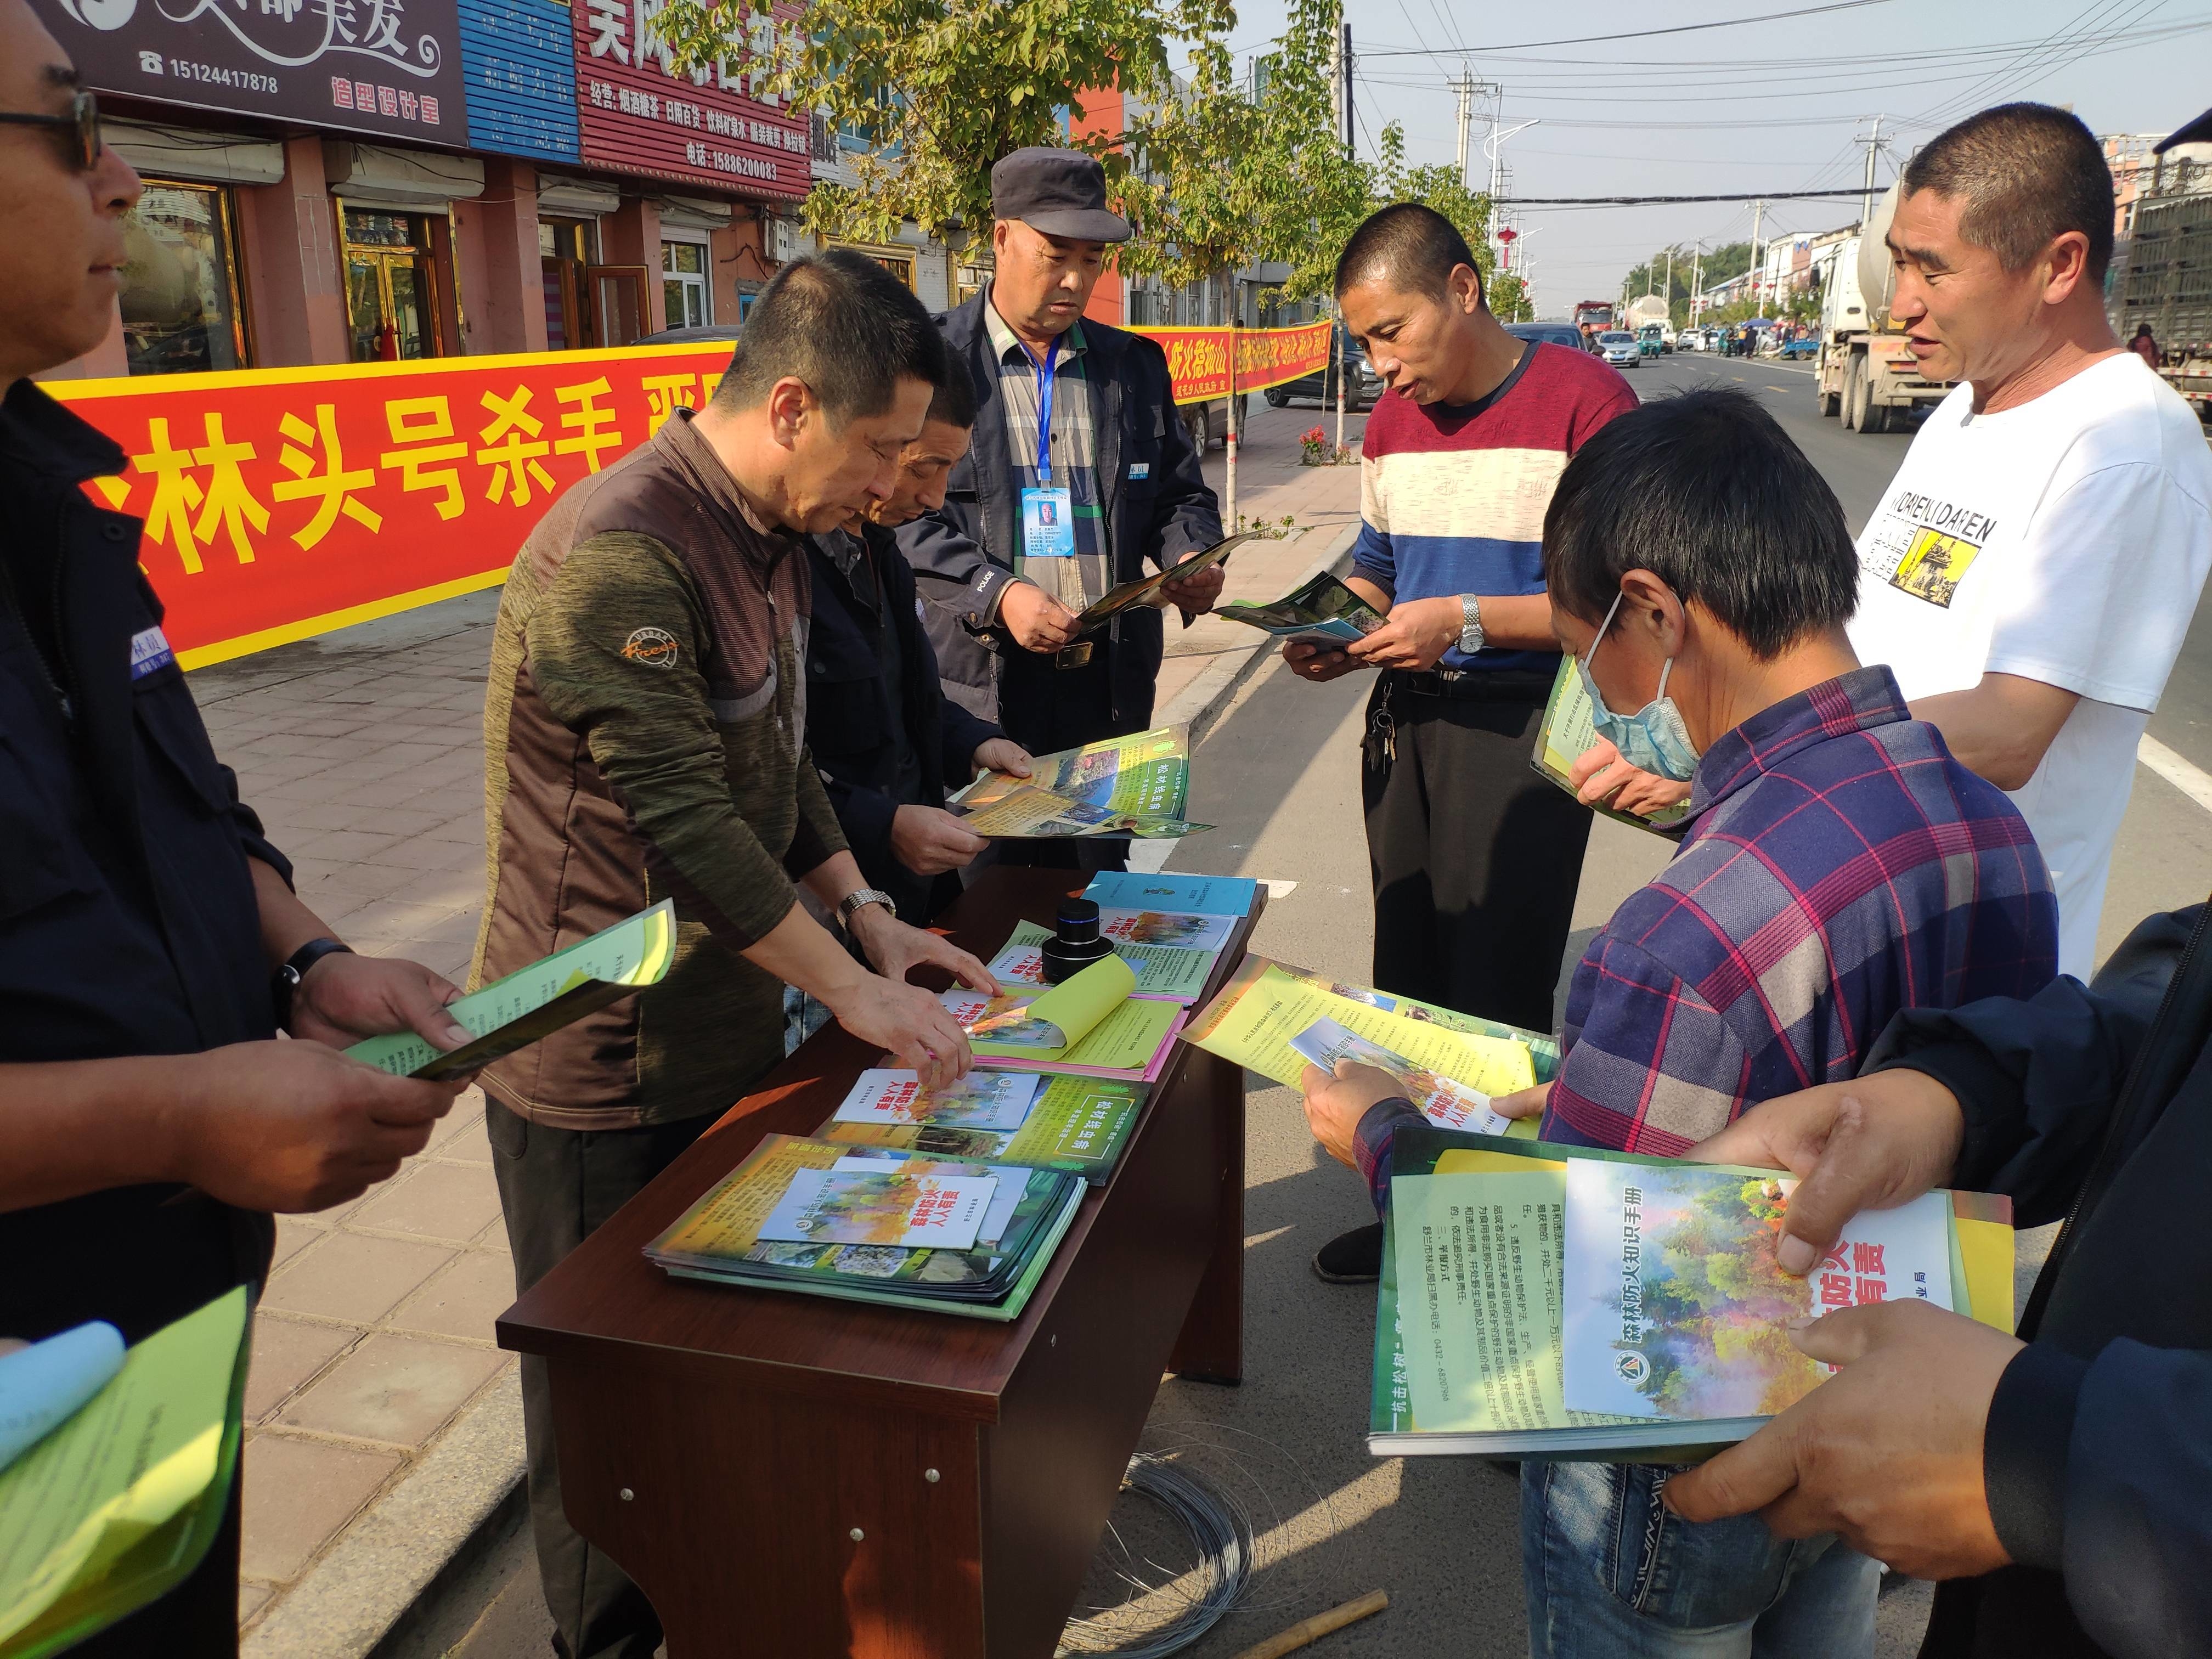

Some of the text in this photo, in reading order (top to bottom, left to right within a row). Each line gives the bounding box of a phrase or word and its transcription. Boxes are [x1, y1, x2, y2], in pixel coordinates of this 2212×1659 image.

[170, 59, 278, 94] 15124417878
[331, 76, 441, 125] 造型设计室
[618, 87, 659, 120] 烟酒糖茶
[665, 100, 701, 129] 日用百货
[706, 109, 746, 139] 饮料矿泉水
[750, 121, 781, 149] 服装裁剪
[783, 129, 806, 154] 换拉锁
[1164, 338, 1226, 382] 防火稳如山
[94, 376, 622, 574] 林头号杀手
[977, 571, 995, 592] POLICE
[634, 630, 669, 641] URBAN
[1147, 763, 1169, 810] 松材线虫病
[1104, 916, 1125, 934] 人人有责
[1116, 917, 1138, 935] 森林防火
[1009, 953, 1037, 974] 人人有责
[1327, 1035, 1356, 1062] 森林防火知识手册
[873, 1080, 898, 1110] 人人有责
[890, 1081, 919, 1112] 森林防火
[984, 1087, 1008, 1122] 森林防火知识手册
[1426, 1087, 1458, 1119] 森林防火
[1446, 1097, 1477, 1127] 人人有责
[1058, 1108, 1082, 1138] 早发现早治理
[1070, 1100, 1114, 1150] 松材线虫病
[802, 1177, 838, 1218] 森林防火知识手册
[909, 1188, 943, 1227] 森林防火
[929, 1189, 962, 1227] 人人有责
[1522, 1203, 1532, 1220] 任。
[1436, 1225, 1450, 1282] 三、举报方式
[1449, 1205, 1465, 1306] 的，依法追究刑事责任。
[1621, 1186, 1644, 1343] 森林防火知识手册
